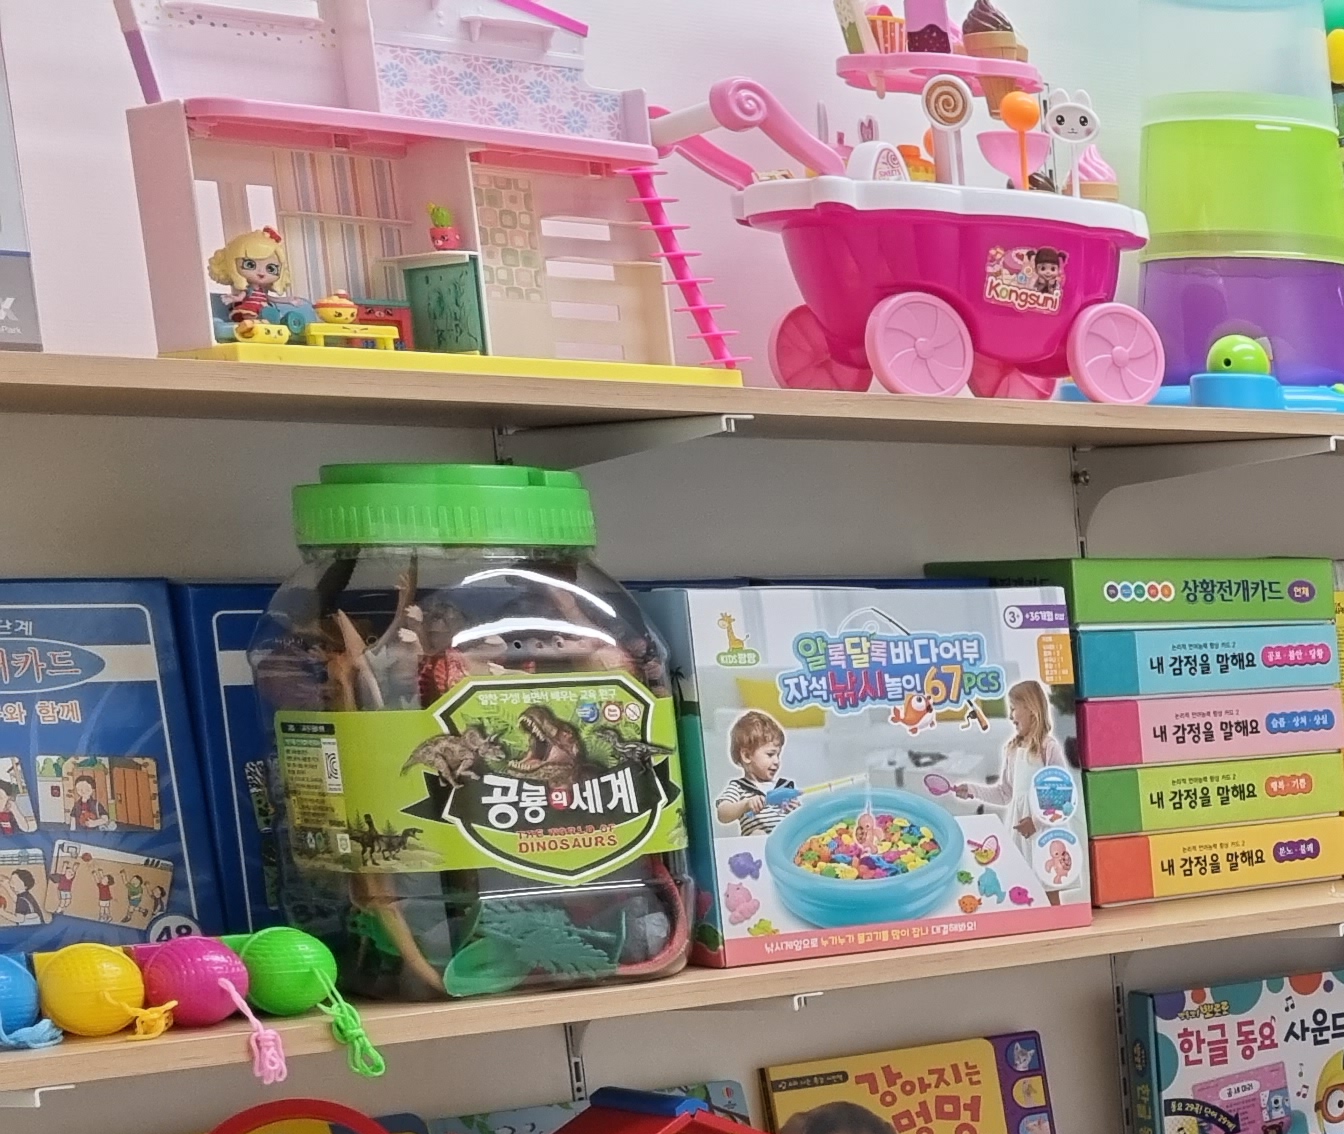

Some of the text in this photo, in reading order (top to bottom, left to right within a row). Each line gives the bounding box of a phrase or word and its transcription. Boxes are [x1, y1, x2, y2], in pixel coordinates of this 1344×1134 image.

[986, 276, 1062, 312] Kongsuni
[1181, 578, 1285, 604] 상황전개카드
[1149, 652, 1257, 677] 내 감정을 말해요
[36, 700, 82, 725] 함께
[1153, 719, 1261, 744] 내 감정을 말해요
[1149, 783, 1258, 811] 내 감정을 말해요
[600, 823, 617, 834] OF
[518, 835, 618, 854] DINOSAURS
[1161, 849, 1266, 877] 내 감정을 말해요
[1177, 1023, 1229, 1067] 한글
[1236, 1019, 1279, 1061] 동요
[855, 1061, 982, 1108] 강아지는
